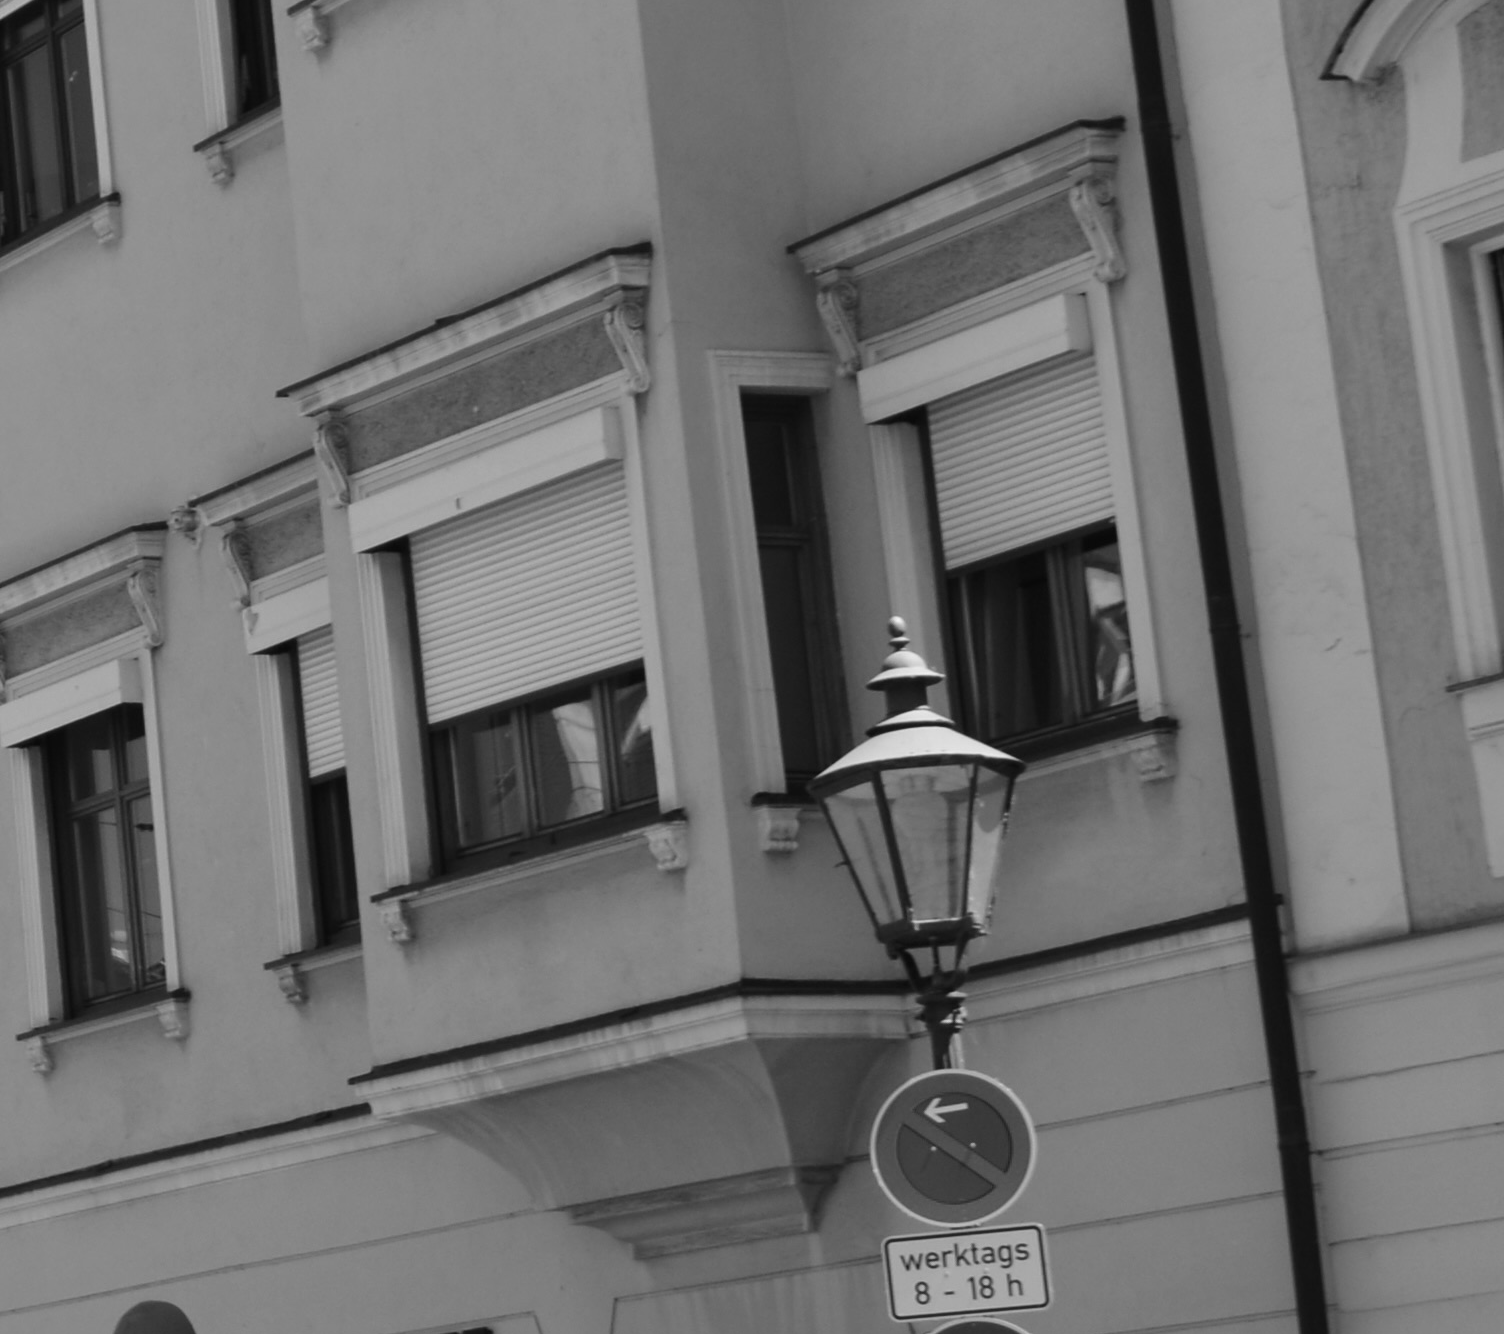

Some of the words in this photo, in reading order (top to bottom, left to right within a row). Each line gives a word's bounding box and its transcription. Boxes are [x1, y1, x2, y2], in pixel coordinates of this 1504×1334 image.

[900, 1243, 1029, 1271] werktags
[915, 1281, 931, 1305] 8
[967, 1275, 995, 1300] 18
[1006, 1273, 1024, 1297] h
